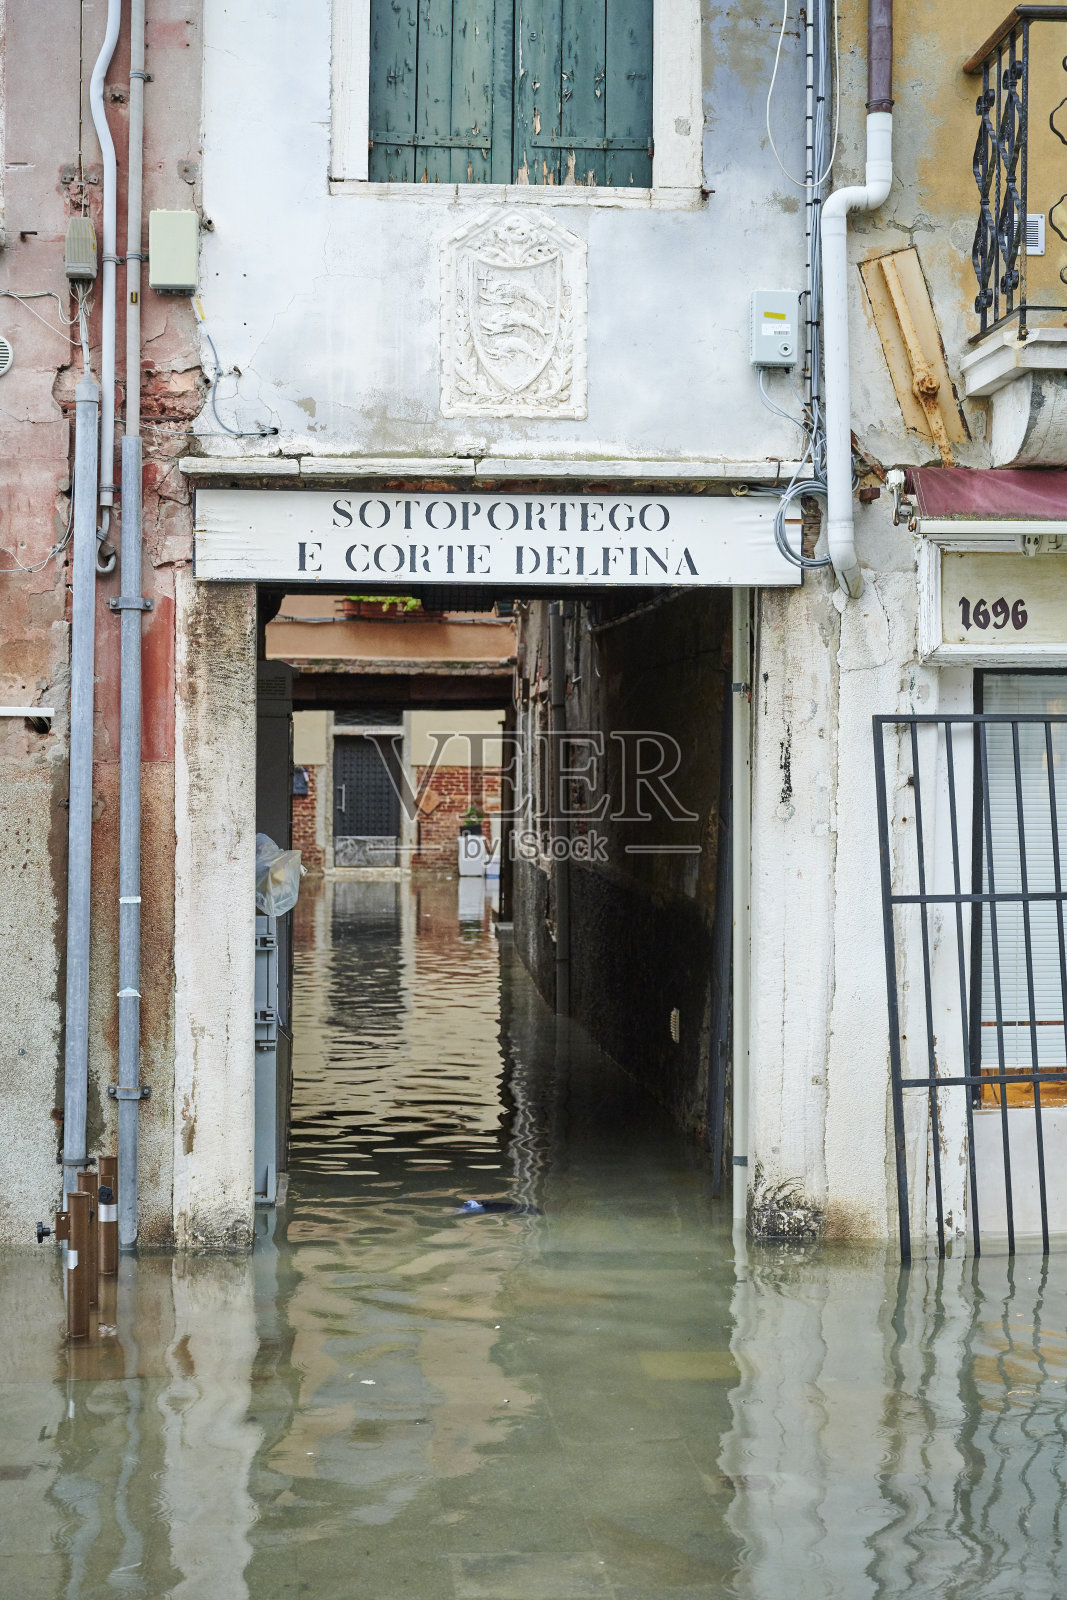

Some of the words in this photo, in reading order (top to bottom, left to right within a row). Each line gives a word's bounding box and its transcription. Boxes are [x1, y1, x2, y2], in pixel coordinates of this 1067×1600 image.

[332, 499, 670, 532] SOTOPORTEGO
[297, 542, 323, 571] E
[345, 544, 491, 575] CORTE
[515, 545, 700, 576] DELFINA
[958, 596, 1028, 631] 1696
